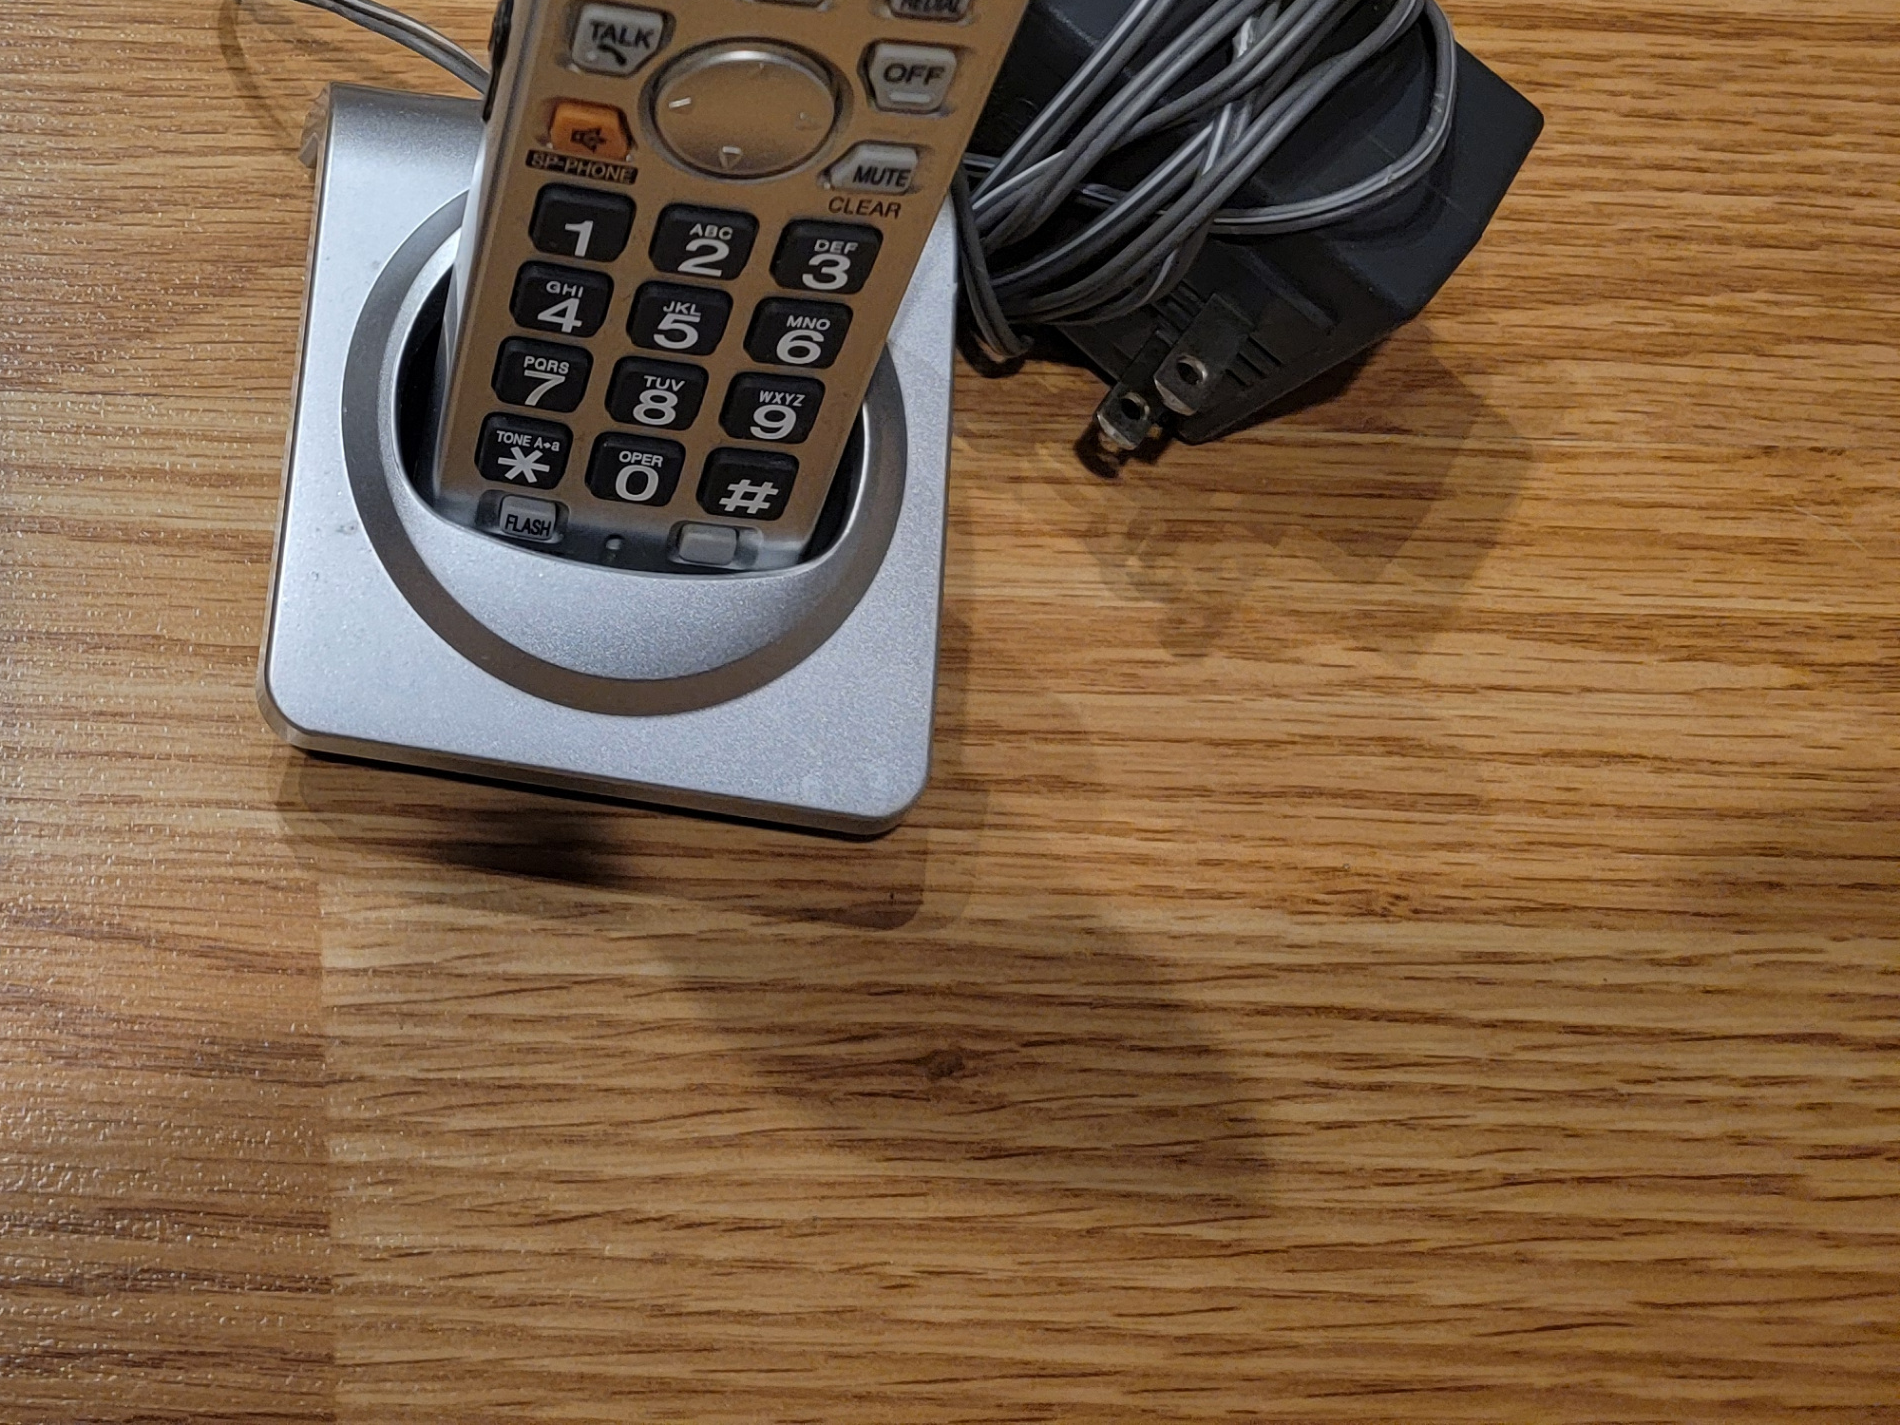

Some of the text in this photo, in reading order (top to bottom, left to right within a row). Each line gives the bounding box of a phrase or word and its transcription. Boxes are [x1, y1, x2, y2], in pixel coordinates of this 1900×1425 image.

[588, 19, 656, 49] TALK
[884, 62, 947, 86] OFF
[531, 152, 633, 183] SP-PHONE
[852, 164, 911, 188] MUTE
[828, 196, 902, 220] CLEAR
[564, 220, 595, 257] 1
[689, 222, 733, 240] ABC
[677, 237, 731, 277] 2
[814, 239, 859, 255] DEF
[802, 252, 852, 291] 3
[546, 280, 584, 298] GHI
[537, 297, 583, 334] 4
[663, 300, 702, 317] JKL
[653, 314, 701, 350] 5
[786, 314, 831, 332] MNO
[775, 328, 827, 365] 6
[523, 355, 570, 375] PQRS
[523, 369, 566, 407] 7
[643, 375, 686, 392] TUV
[632, 389, 680, 426] 8
[758, 390, 806, 407] WXYZ
[749, 404, 798, 441] 9
[496, 429, 533, 448] TONE
[618, 450, 663, 468] OPER
[614, 465, 660, 502] 0
[718, 478, 780, 515] #
[504, 513, 552, 537] FLASH
